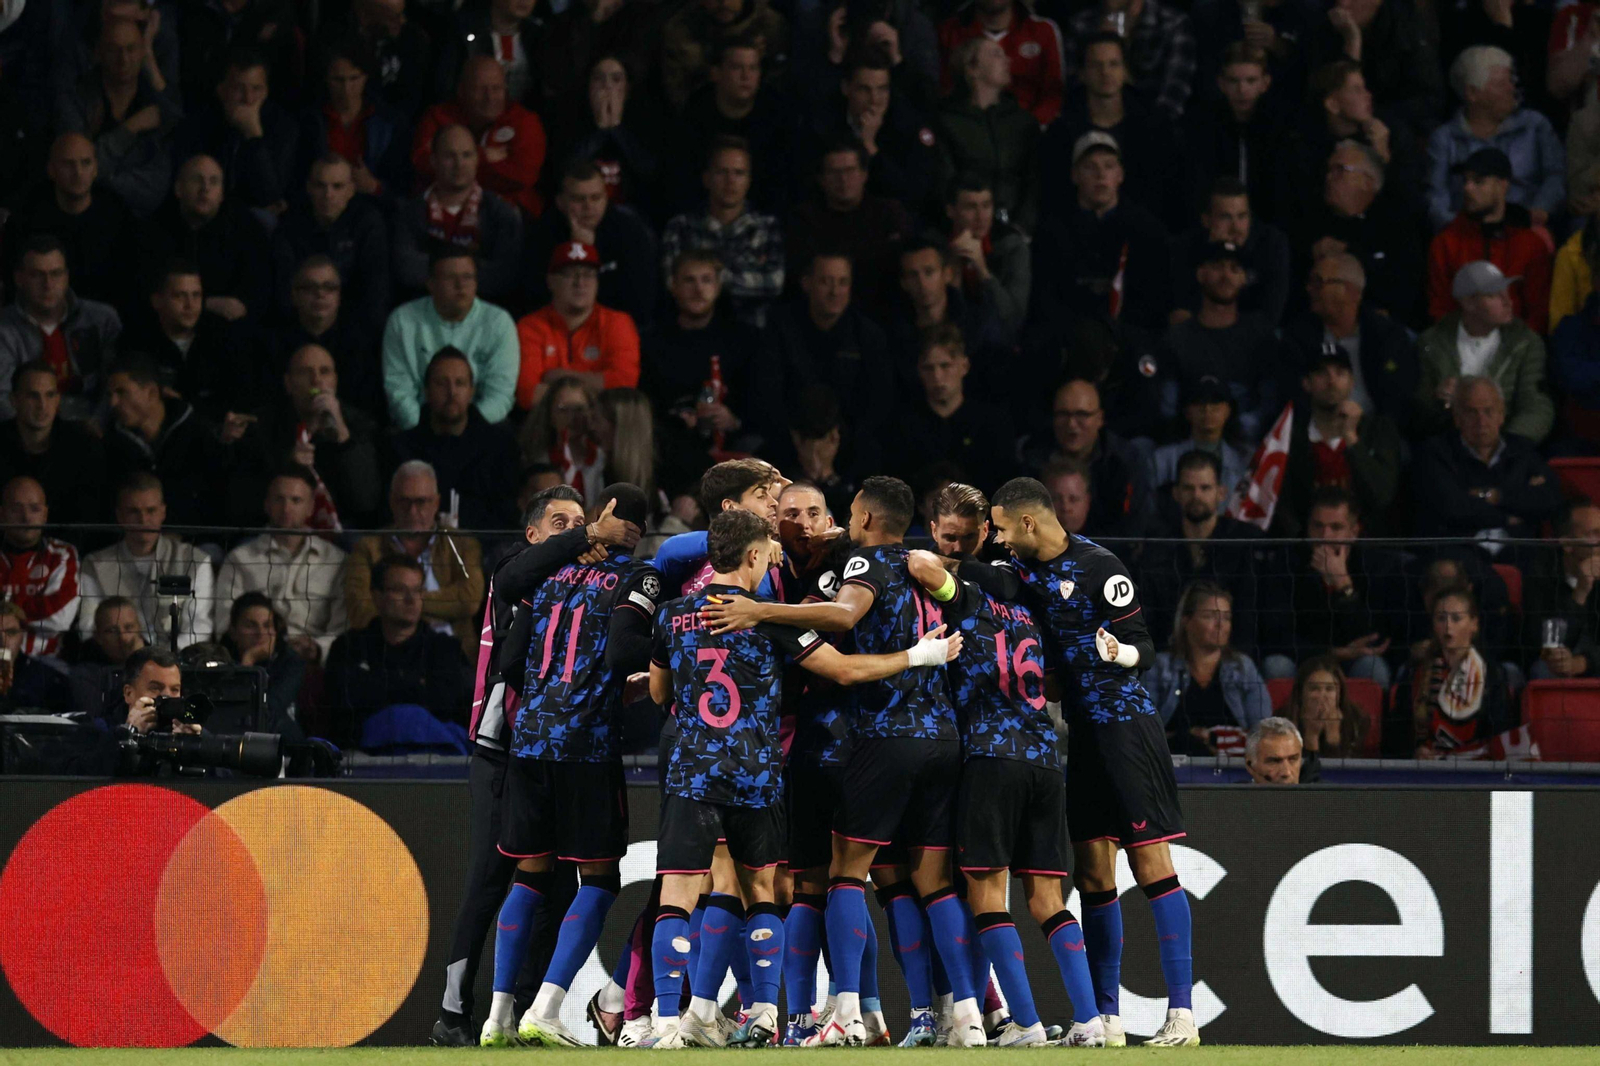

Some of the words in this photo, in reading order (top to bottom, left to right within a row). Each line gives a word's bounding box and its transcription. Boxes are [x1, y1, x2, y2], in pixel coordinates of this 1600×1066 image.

[844, 561, 866, 576] JD
[1111, 581, 1130, 602] JD
[537, 600, 586, 684] 11
[993, 628, 1047, 711] 16
[696, 647, 741, 729] 3
